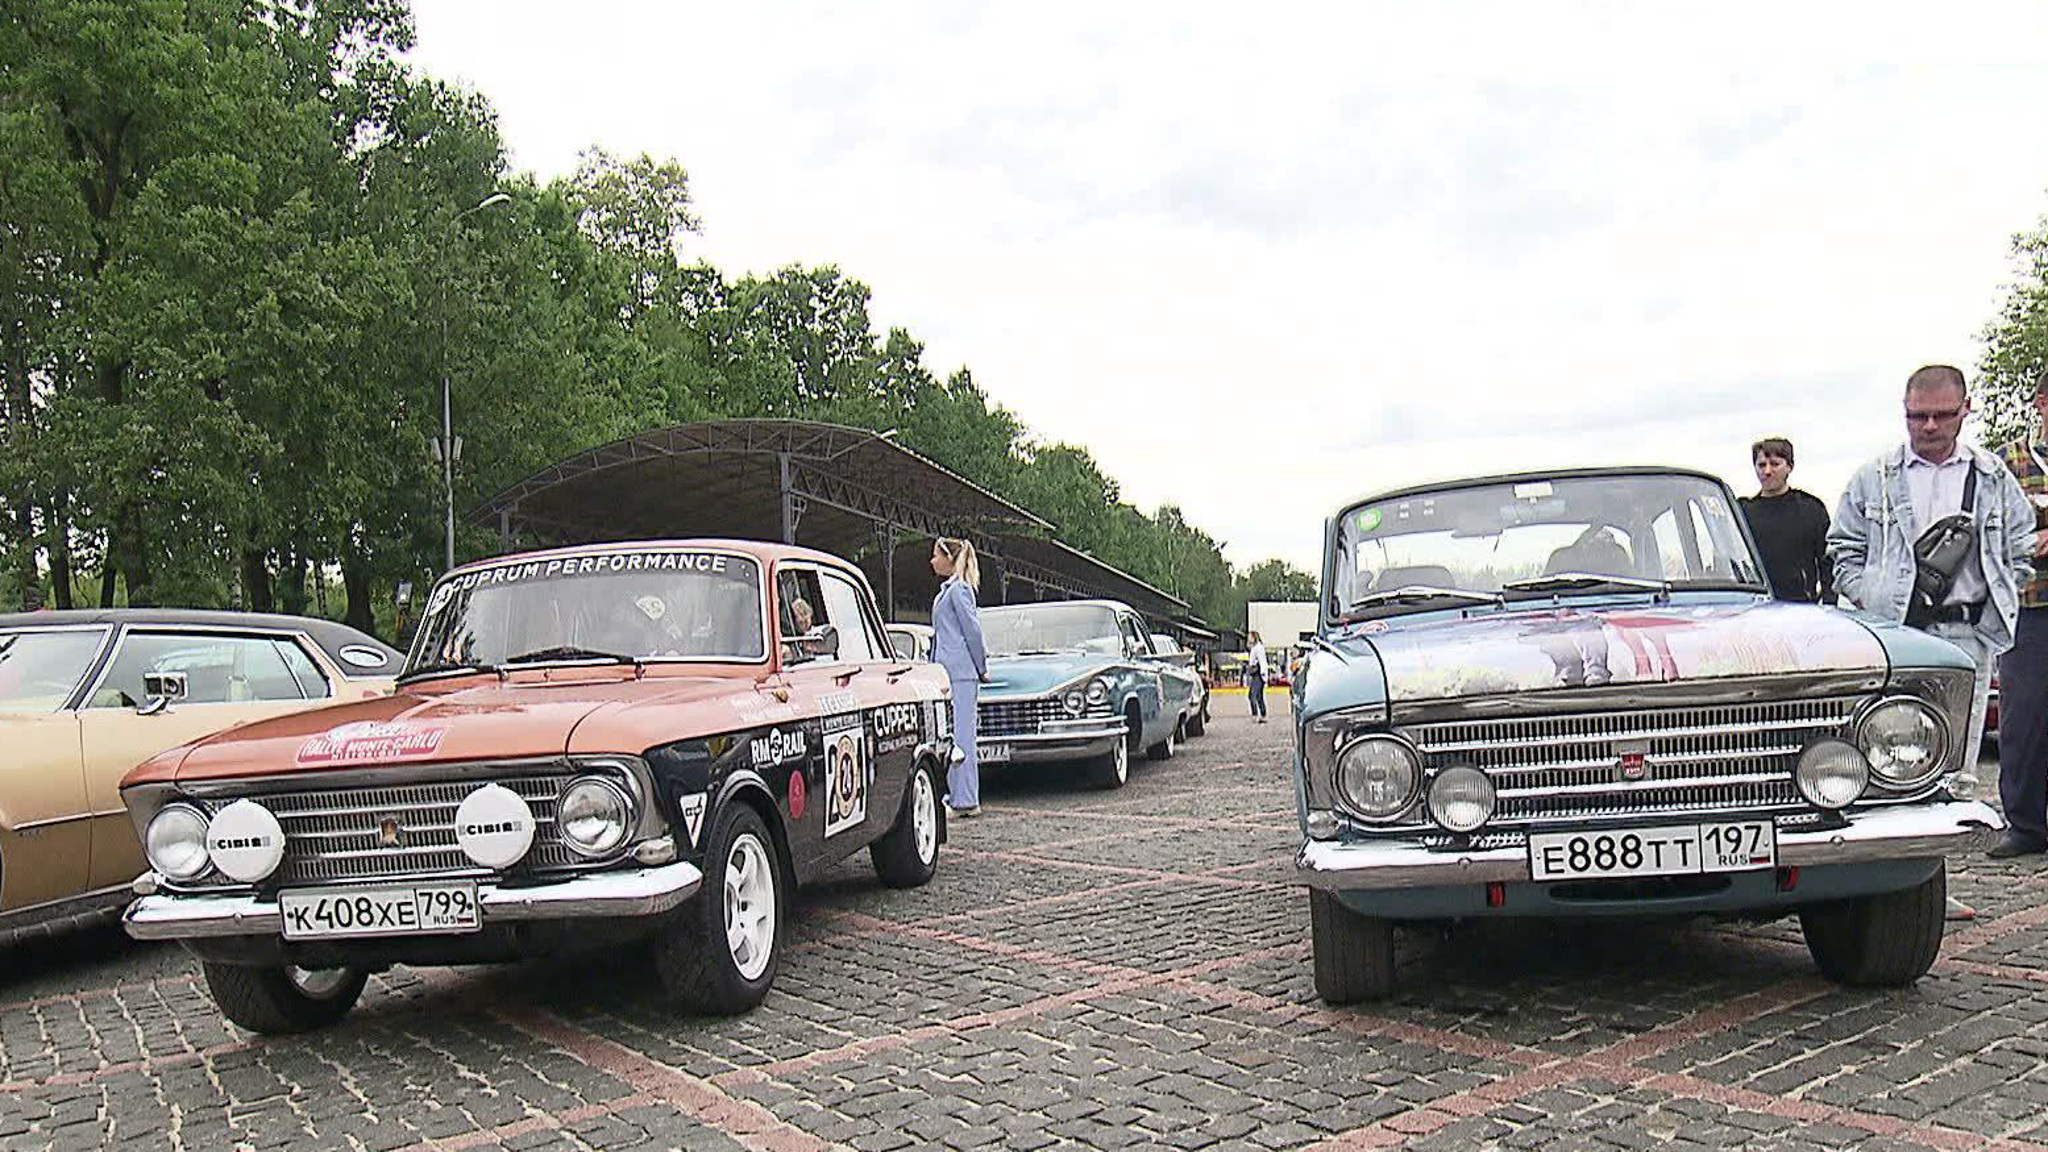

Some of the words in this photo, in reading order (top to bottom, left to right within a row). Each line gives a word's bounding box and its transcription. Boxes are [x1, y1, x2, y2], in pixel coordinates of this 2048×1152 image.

[452, 562, 539, 592] CUPRUM
[546, 554, 727, 576] PERFORMANCE
[874, 703, 918, 737] CUPPER
[750, 738, 771, 764] RM
[783, 731, 806, 757] RAIL
[1705, 825, 1762, 855] 197
[1718, 854, 1747, 866] RUS
[418, 891, 467, 915] 799
[433, 915, 456, 925] RUS
